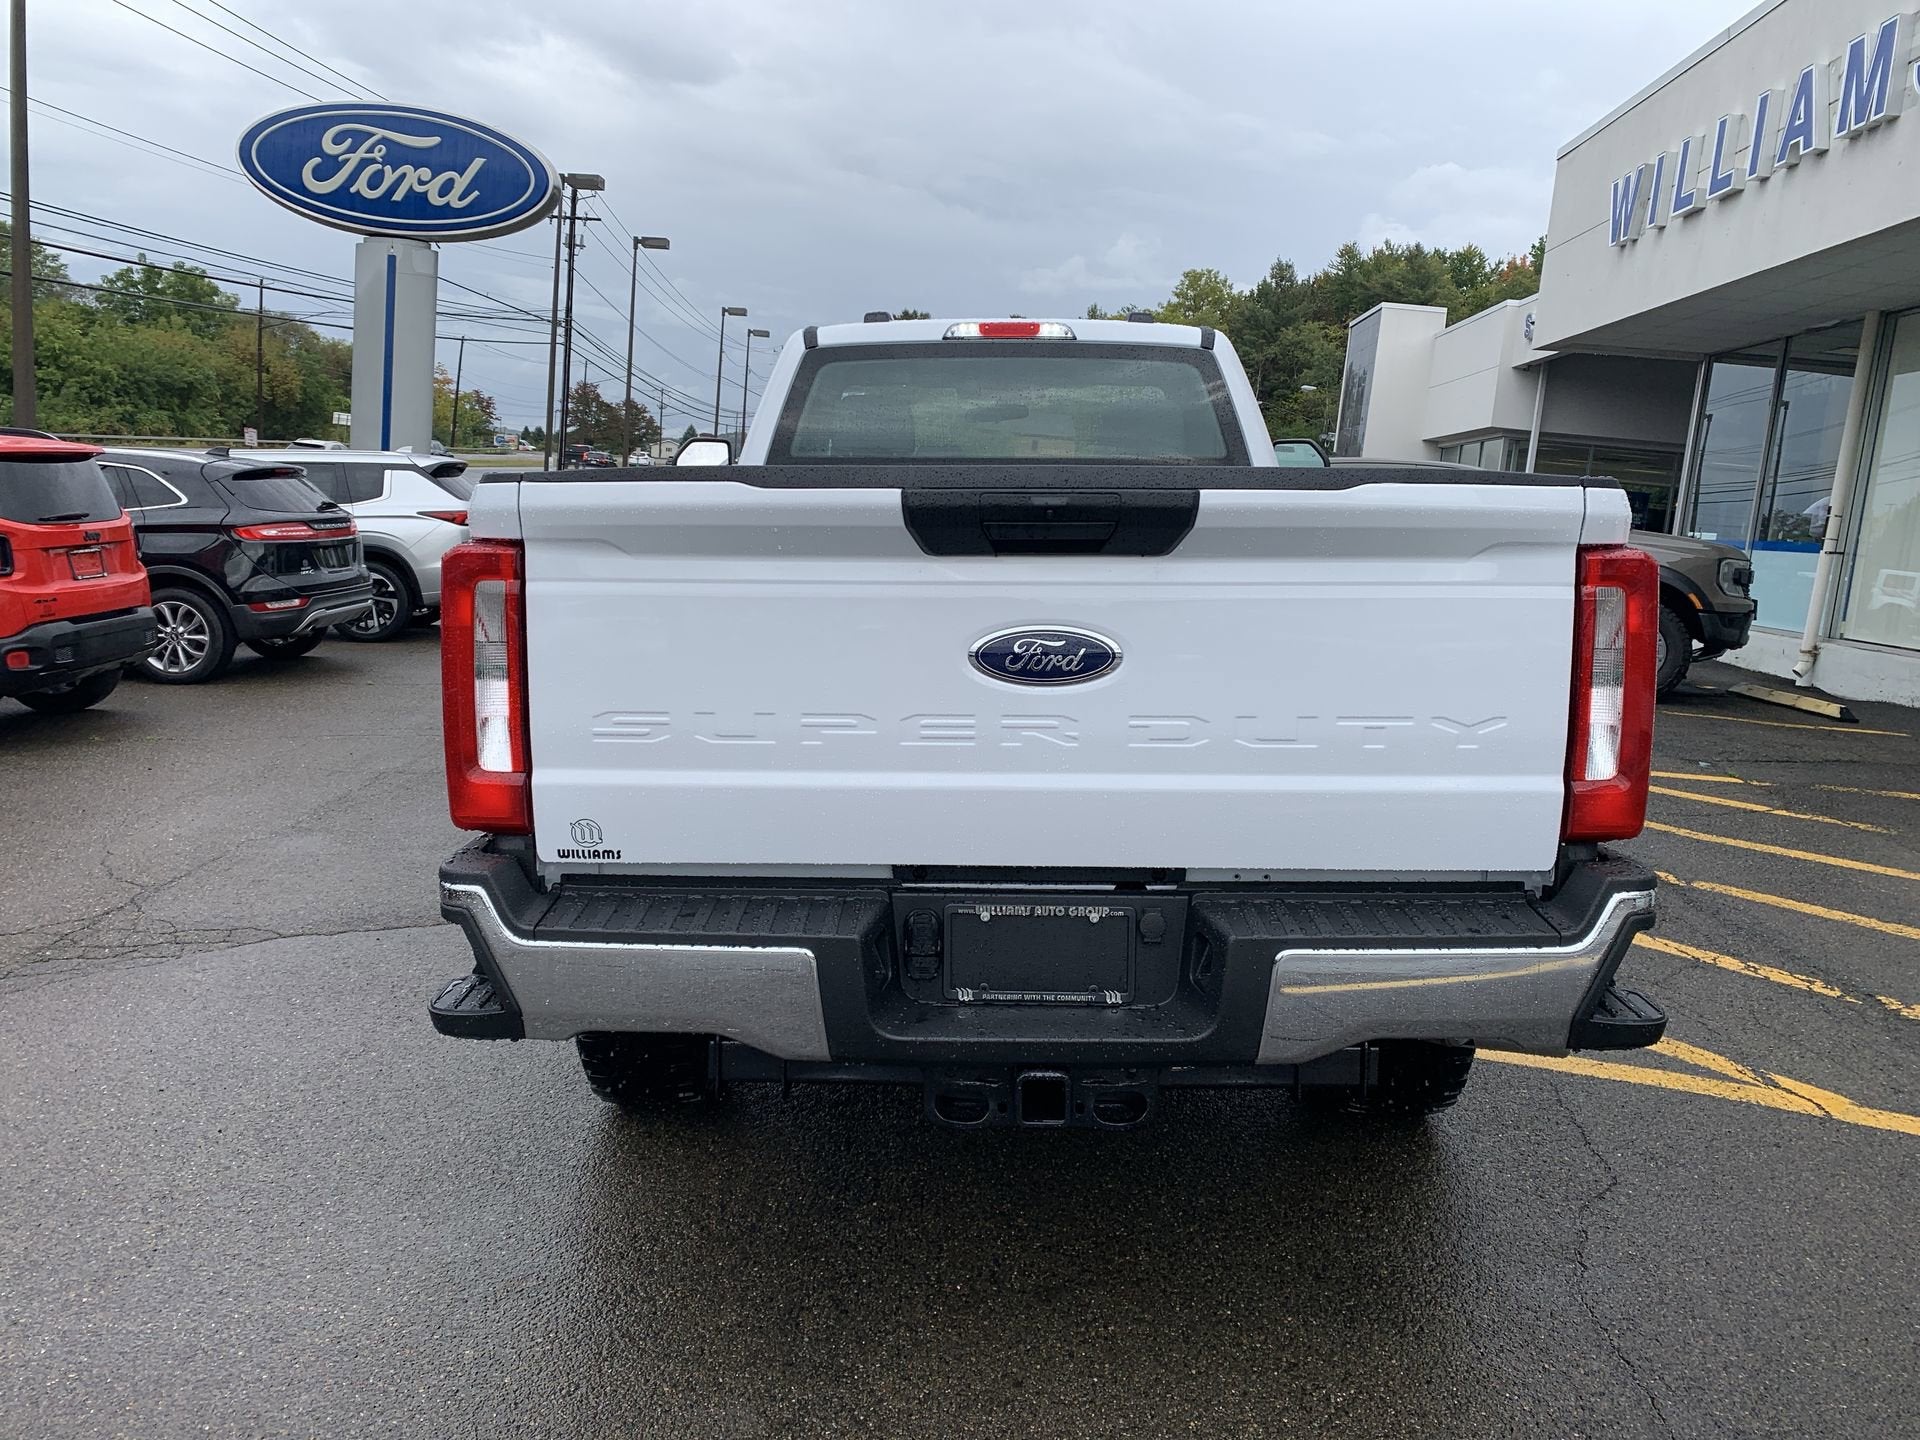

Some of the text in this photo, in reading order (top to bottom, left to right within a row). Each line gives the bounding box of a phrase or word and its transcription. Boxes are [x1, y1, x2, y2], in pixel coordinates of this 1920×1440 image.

[1609, 12, 1920, 247] WILLIAM
[302, 123, 487, 209] Ford
[1005, 638, 1086, 672] Ford
[592, 711, 1507, 748] SUPER DUTY
[557, 849, 622, 860] WILLIAMS
[1034, 906, 1065, 917] AUTO
